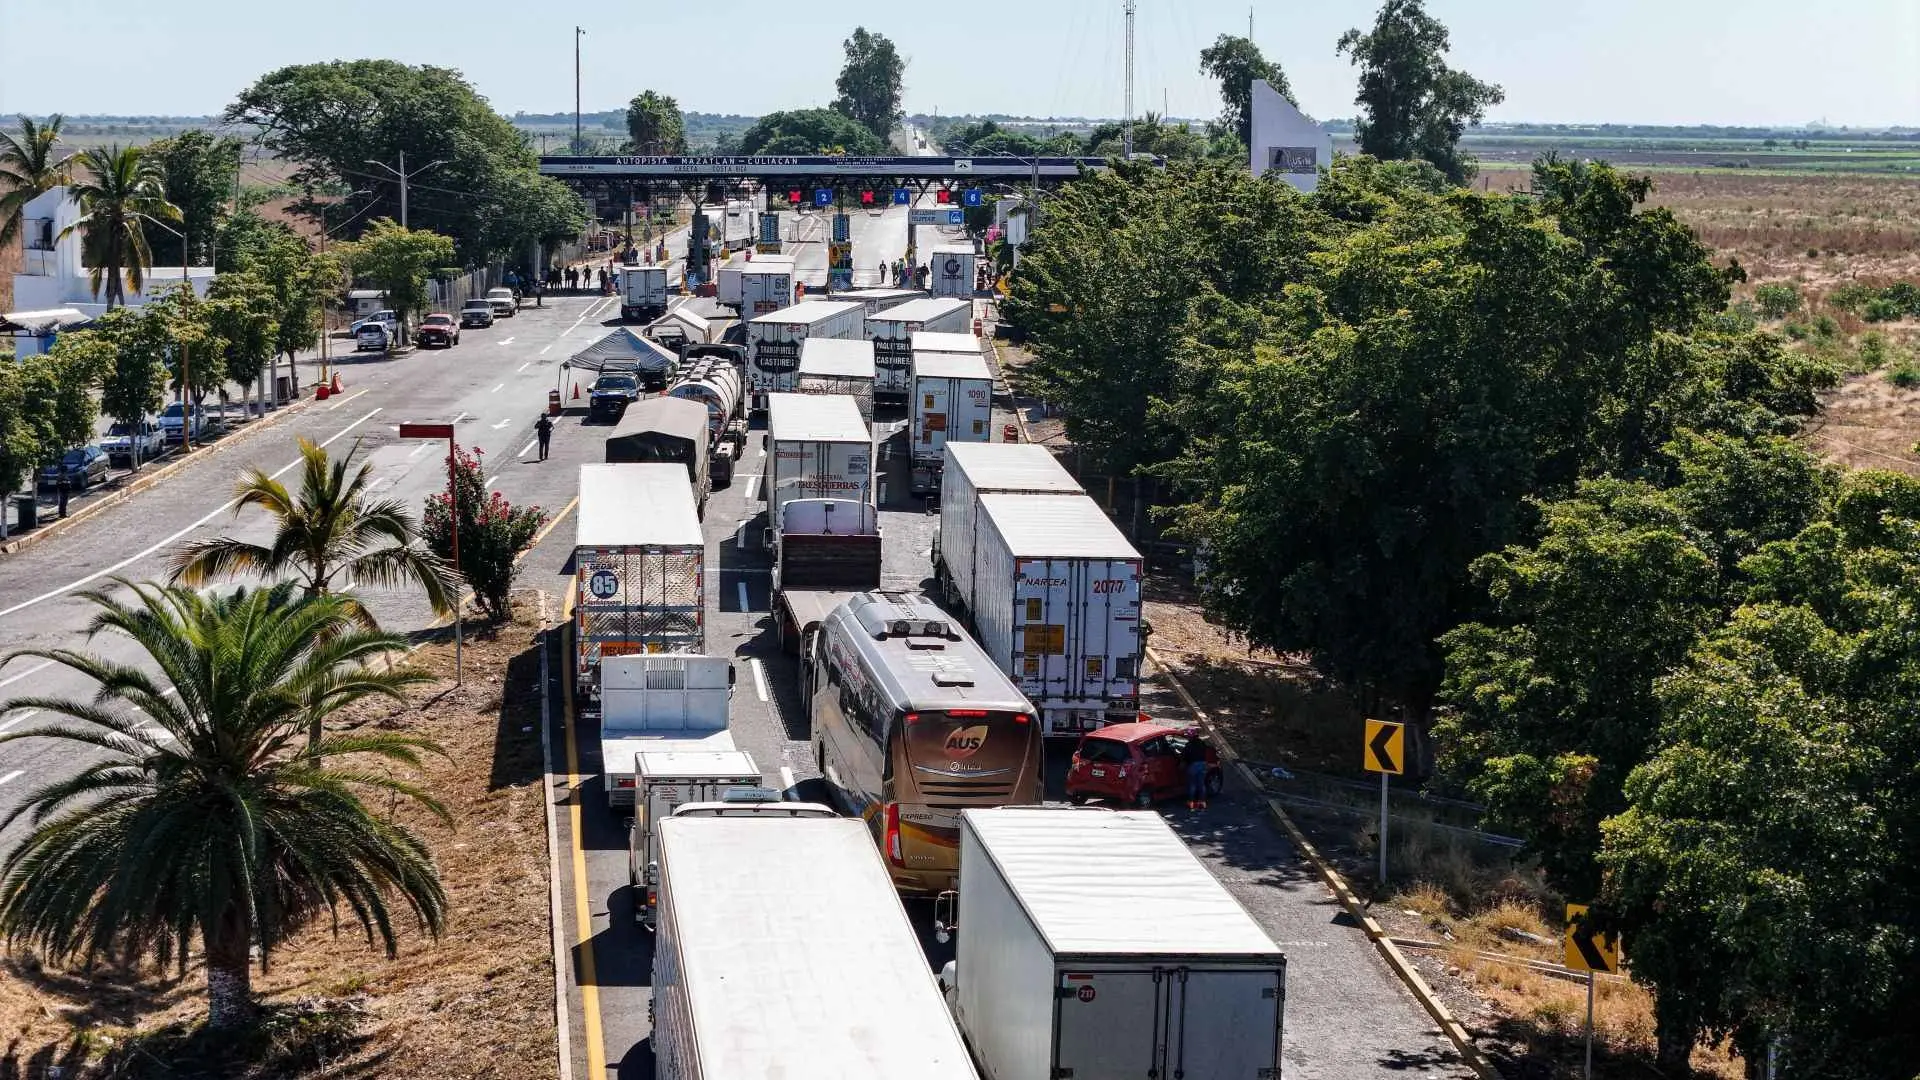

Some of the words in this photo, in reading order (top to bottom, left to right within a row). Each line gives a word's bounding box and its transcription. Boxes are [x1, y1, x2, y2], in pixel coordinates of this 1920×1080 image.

[616, 157, 668, 165] AUTOPISTA
[967, 389, 986, 399] 1090
[593, 576, 616, 594] 85
[1025, 578, 1067, 587] NARCEA
[946, 737, 980, 750] AUS
